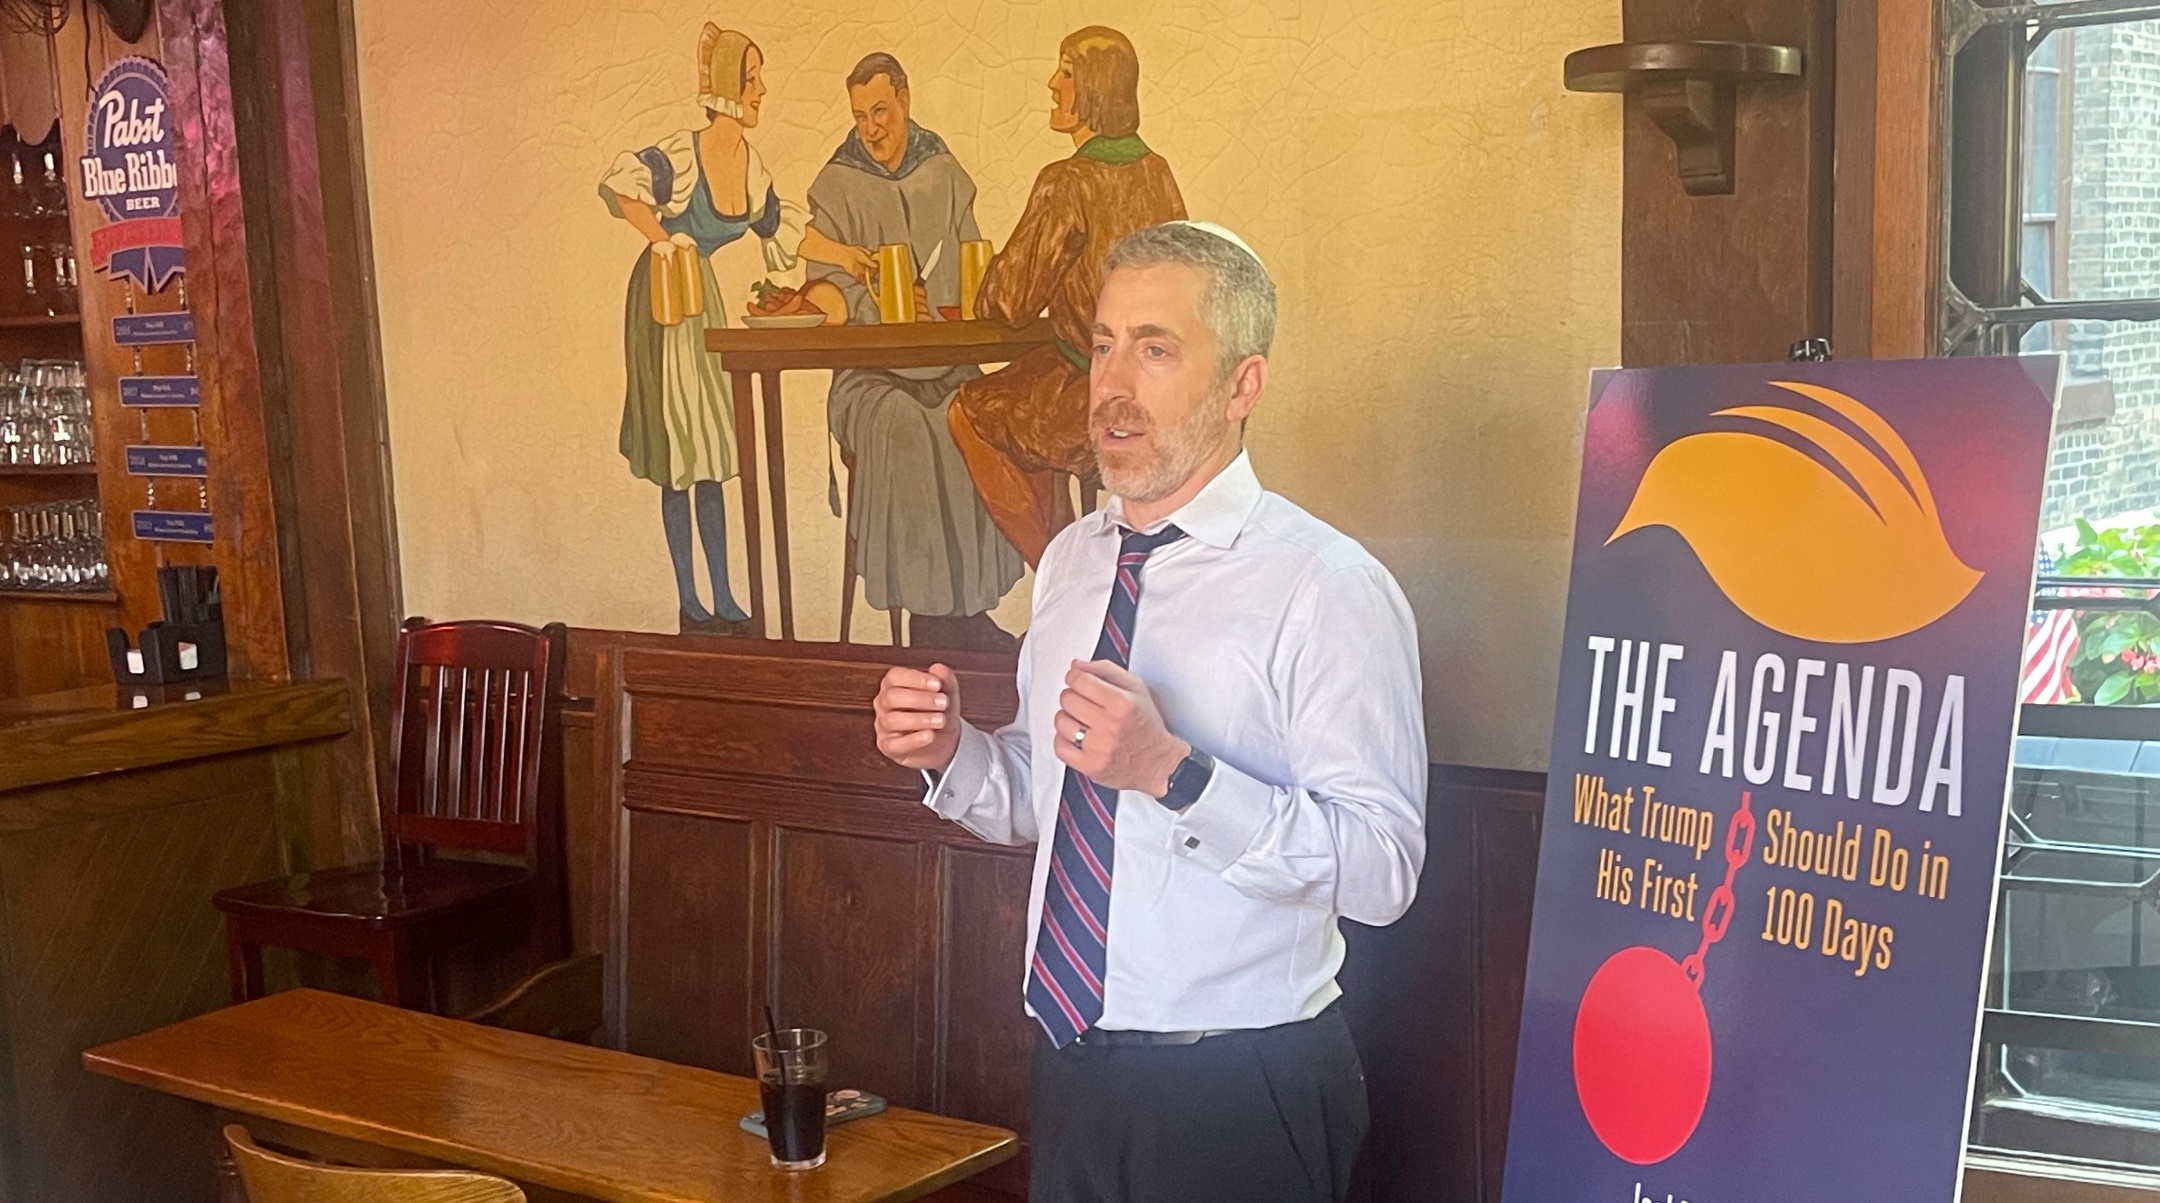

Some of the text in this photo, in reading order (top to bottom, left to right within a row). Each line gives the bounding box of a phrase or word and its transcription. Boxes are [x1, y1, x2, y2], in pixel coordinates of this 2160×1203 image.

[99, 90, 165, 148] Pabst
[81, 157, 128, 198] Blue
[126, 196, 160, 211] BEER
[1584, 635, 1966, 817] THE AGENDA
[1573, 773, 1950, 900] What Trump Should Do in
[1596, 848, 1894, 978] His First 100 Days
